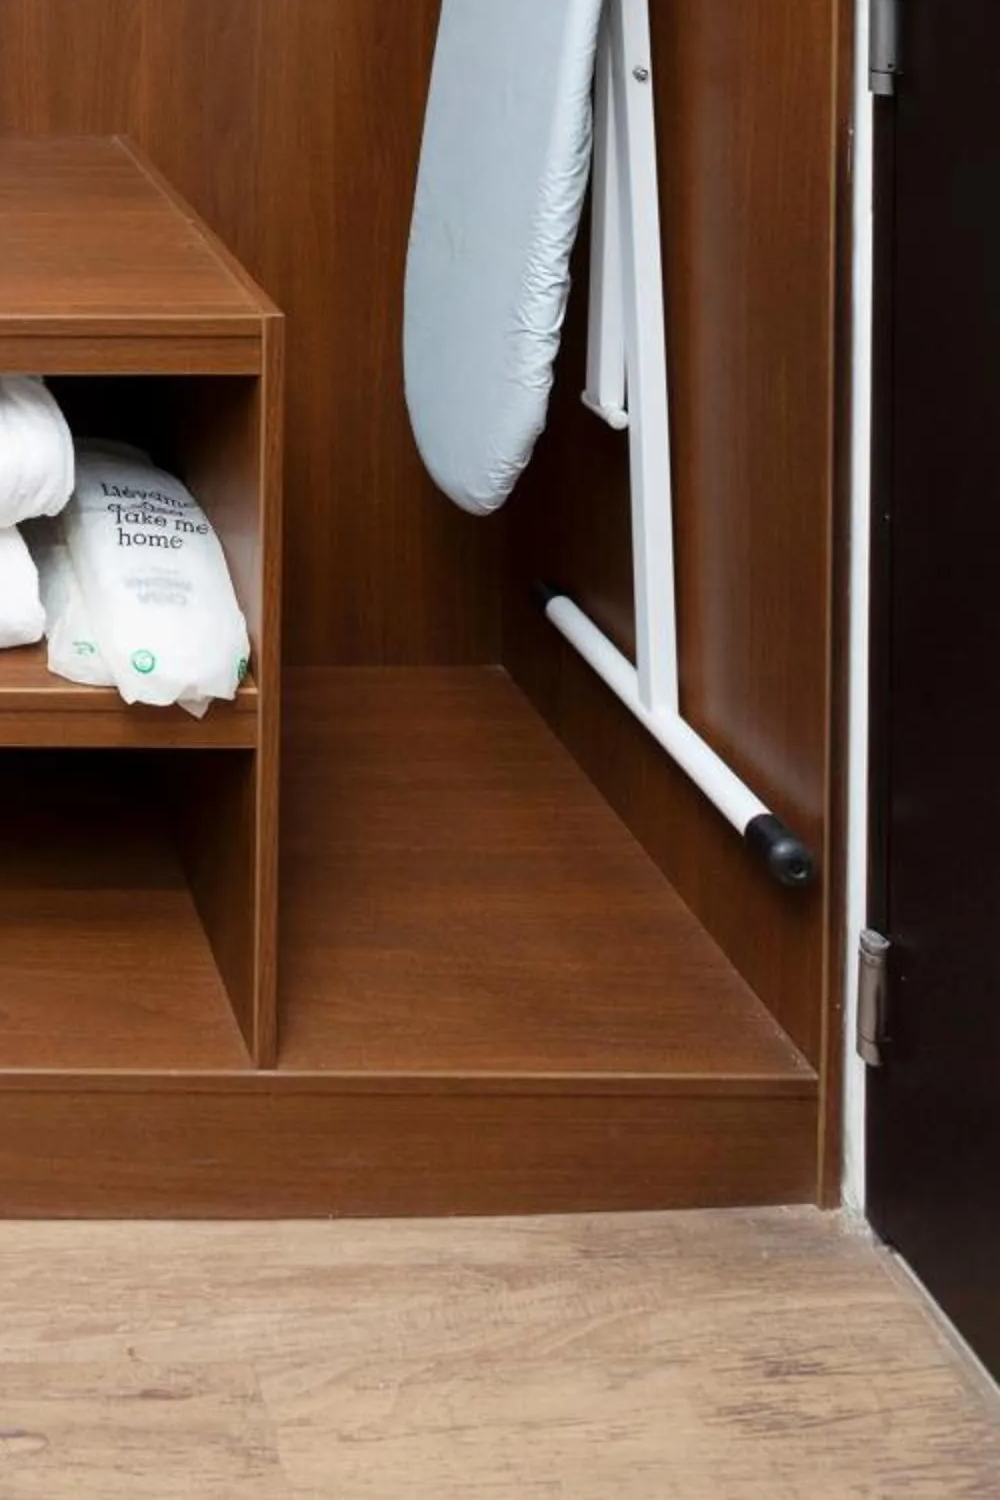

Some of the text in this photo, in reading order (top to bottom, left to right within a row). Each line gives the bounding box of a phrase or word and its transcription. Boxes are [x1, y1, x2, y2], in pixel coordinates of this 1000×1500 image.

[107, 503, 168, 527] Take
[176, 518, 208, 535] me
[117, 527, 183, 549] home
